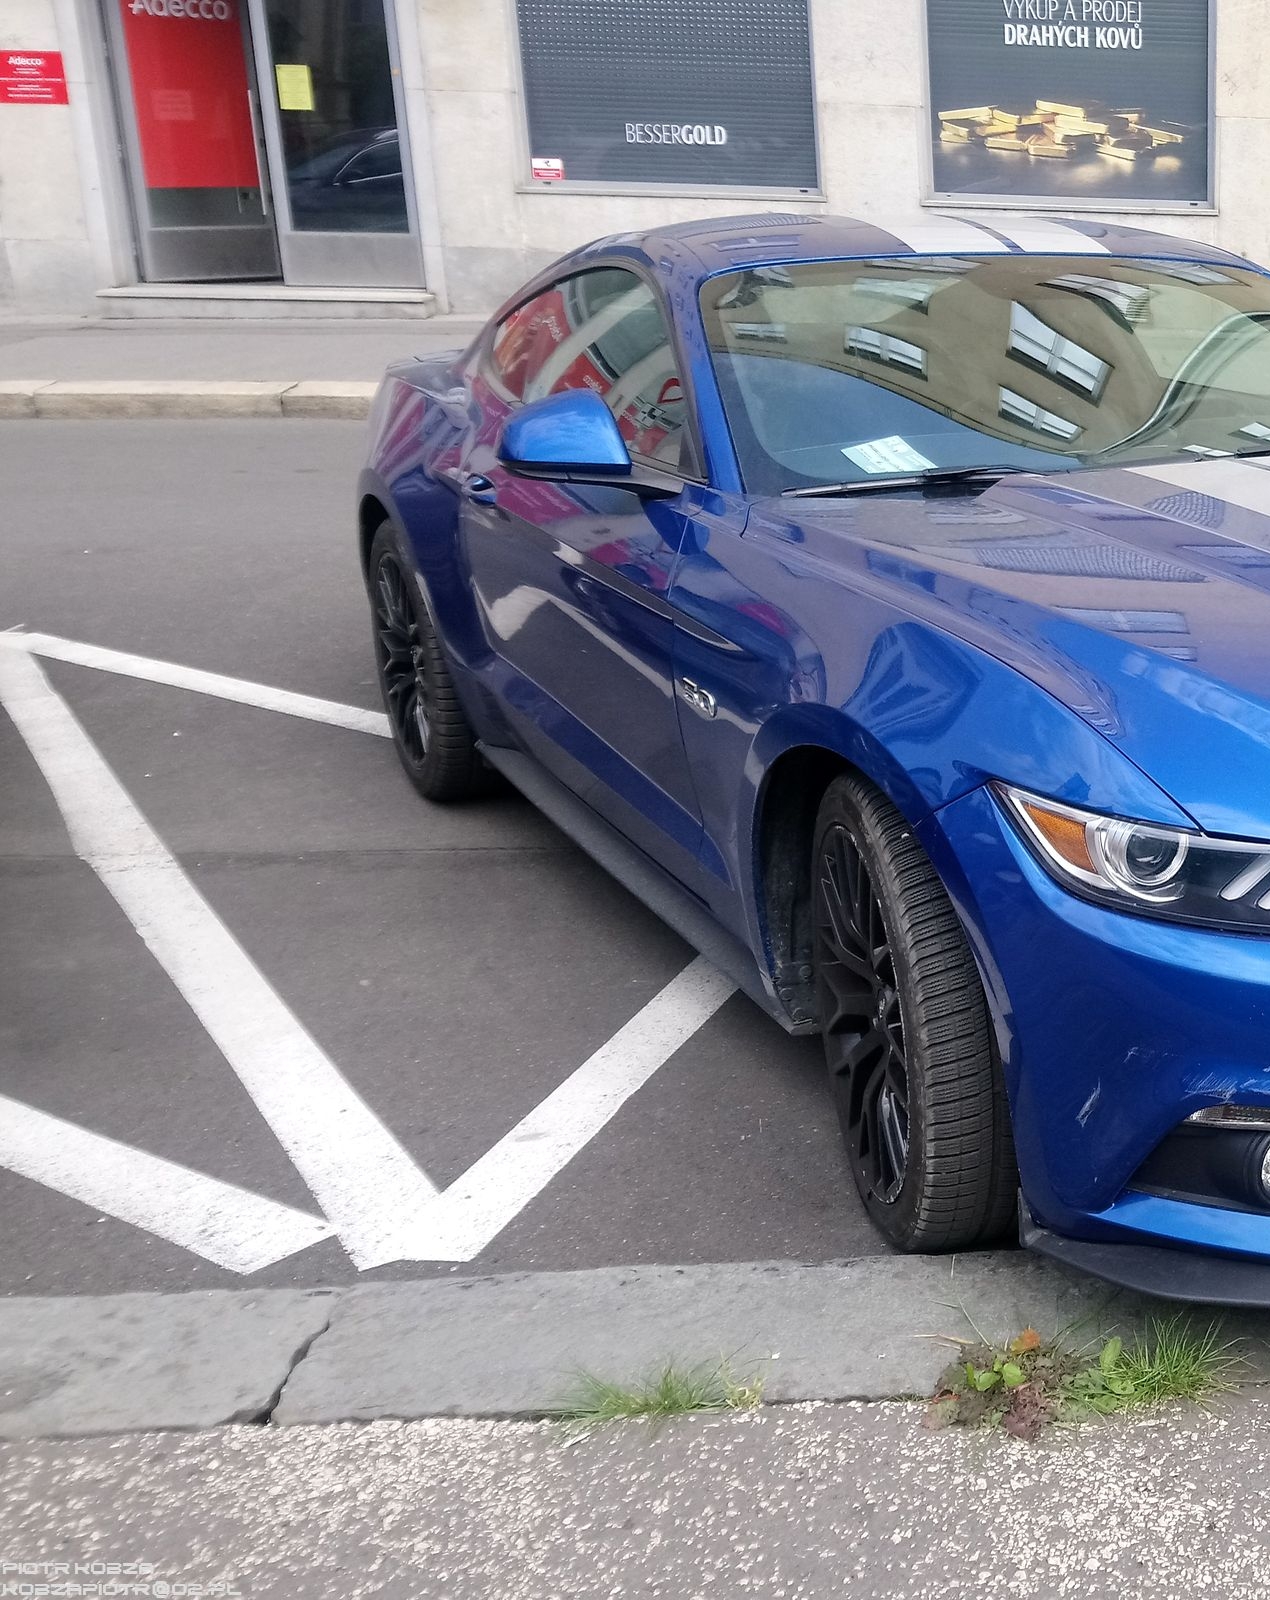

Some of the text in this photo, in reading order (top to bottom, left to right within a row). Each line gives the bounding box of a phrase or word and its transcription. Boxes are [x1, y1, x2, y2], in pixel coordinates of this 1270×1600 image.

[1063, 0, 1077, 20] A
[1082, 0, 1142, 23] PRODEJ
[1004, 20, 1142, 49] DRAHÝCH KOVŮ
[8, 56, 42, 66] Adecco
[625, 123, 727, 145] BESSERGOLD
